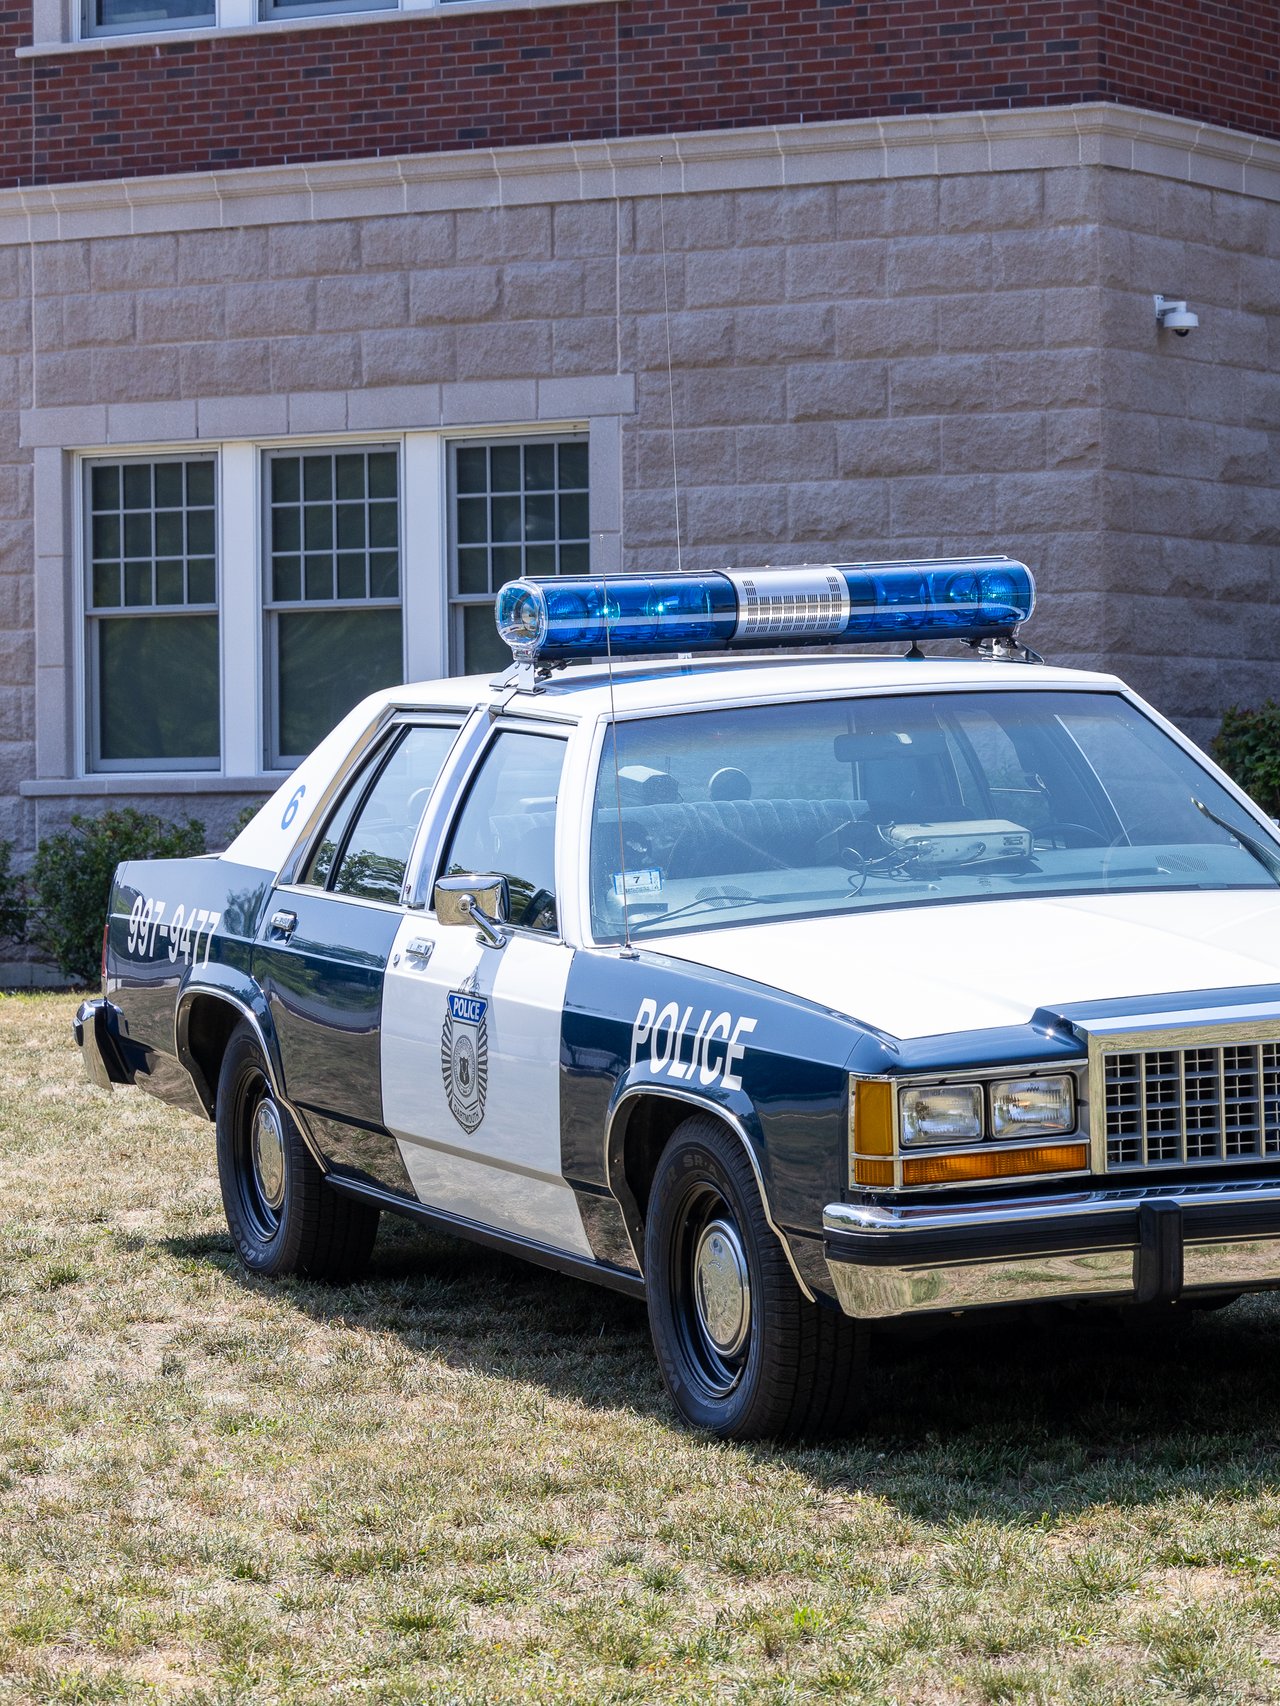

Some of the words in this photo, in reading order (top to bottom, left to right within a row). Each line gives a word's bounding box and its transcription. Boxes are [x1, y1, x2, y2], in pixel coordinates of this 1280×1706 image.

[280, 784, 306, 830] 6
[633, 876, 640, 884] 7
[127, 896, 222, 970] 997-9477
[453, 997, 481, 1020] POLICE
[630, 997, 758, 1091] POLICE
